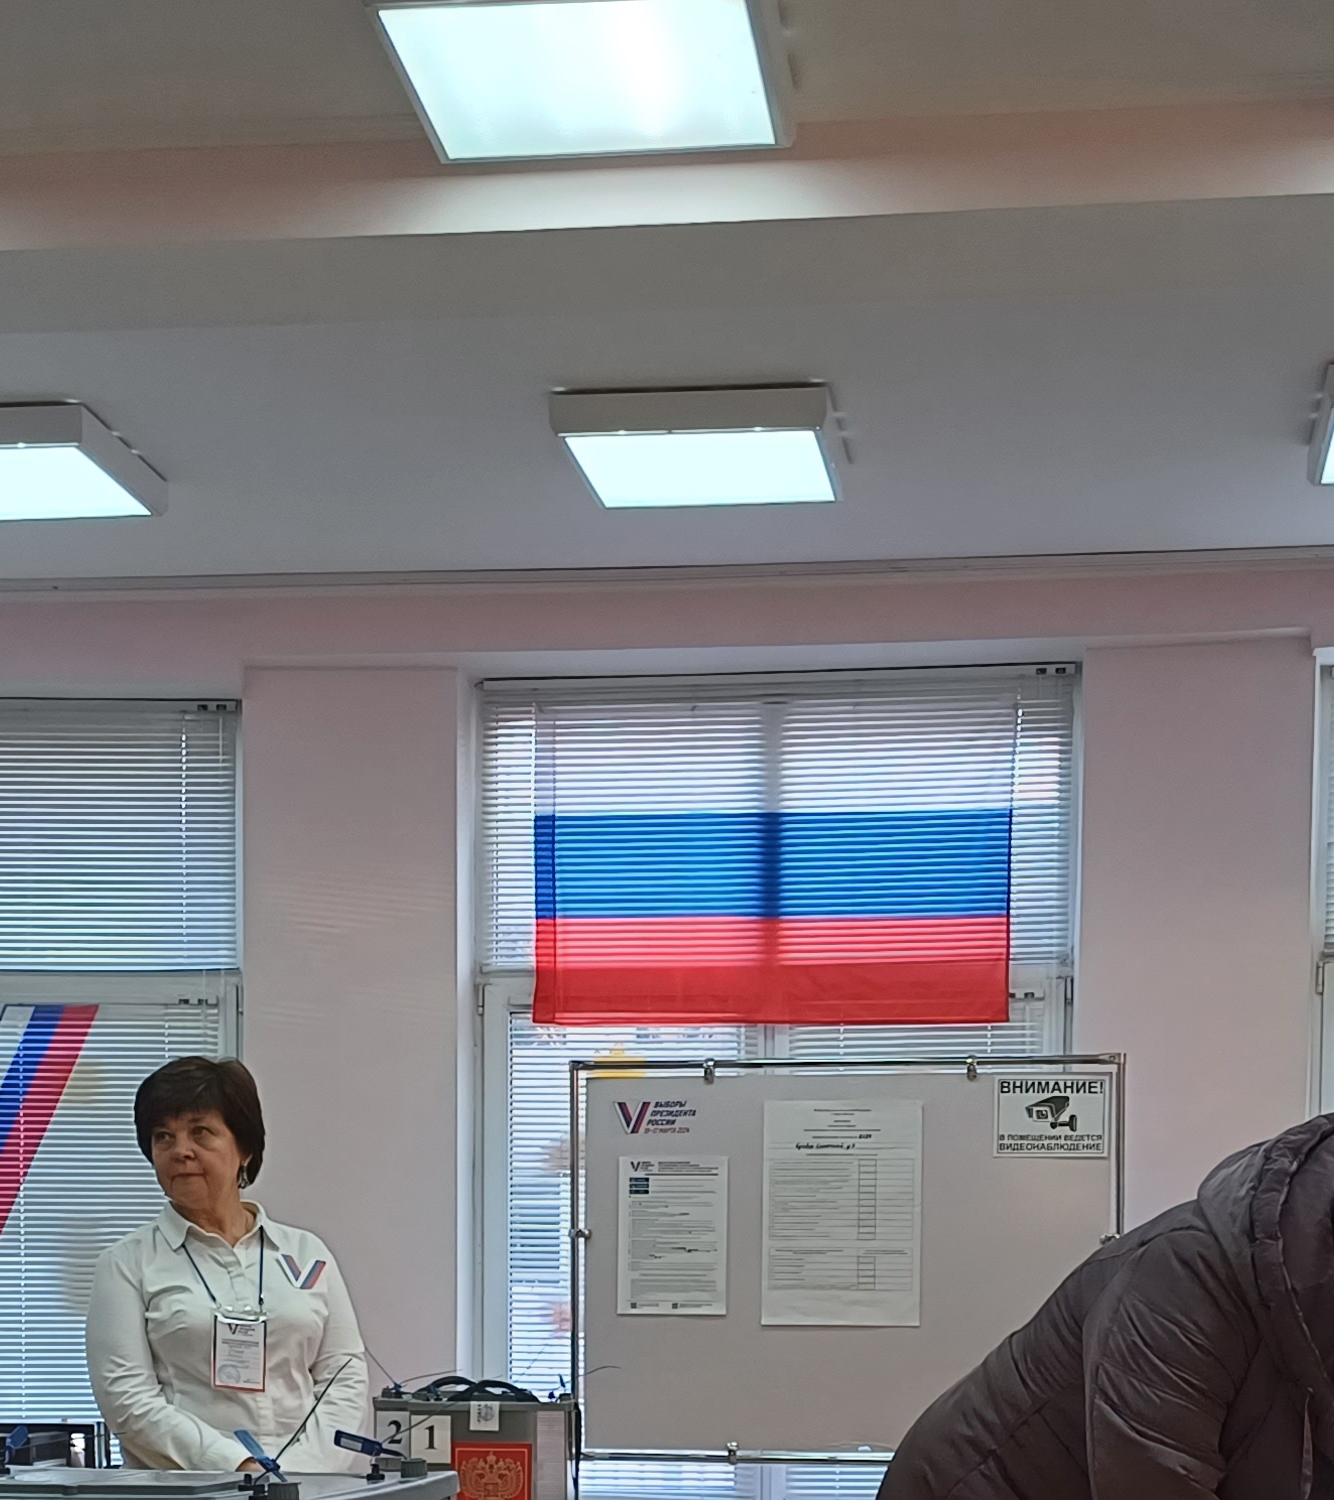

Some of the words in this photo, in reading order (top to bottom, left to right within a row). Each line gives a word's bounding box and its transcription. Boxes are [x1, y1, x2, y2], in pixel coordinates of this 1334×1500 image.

[1000, 1081, 1104, 1094] ВНИМАНИЕ!
[999, 1143, 1102, 1152] ВИДЕОНАБЛЮДЕНИЕ
[387, 1420, 403, 1445] 2
[425, 1425, 438, 1450] 1
